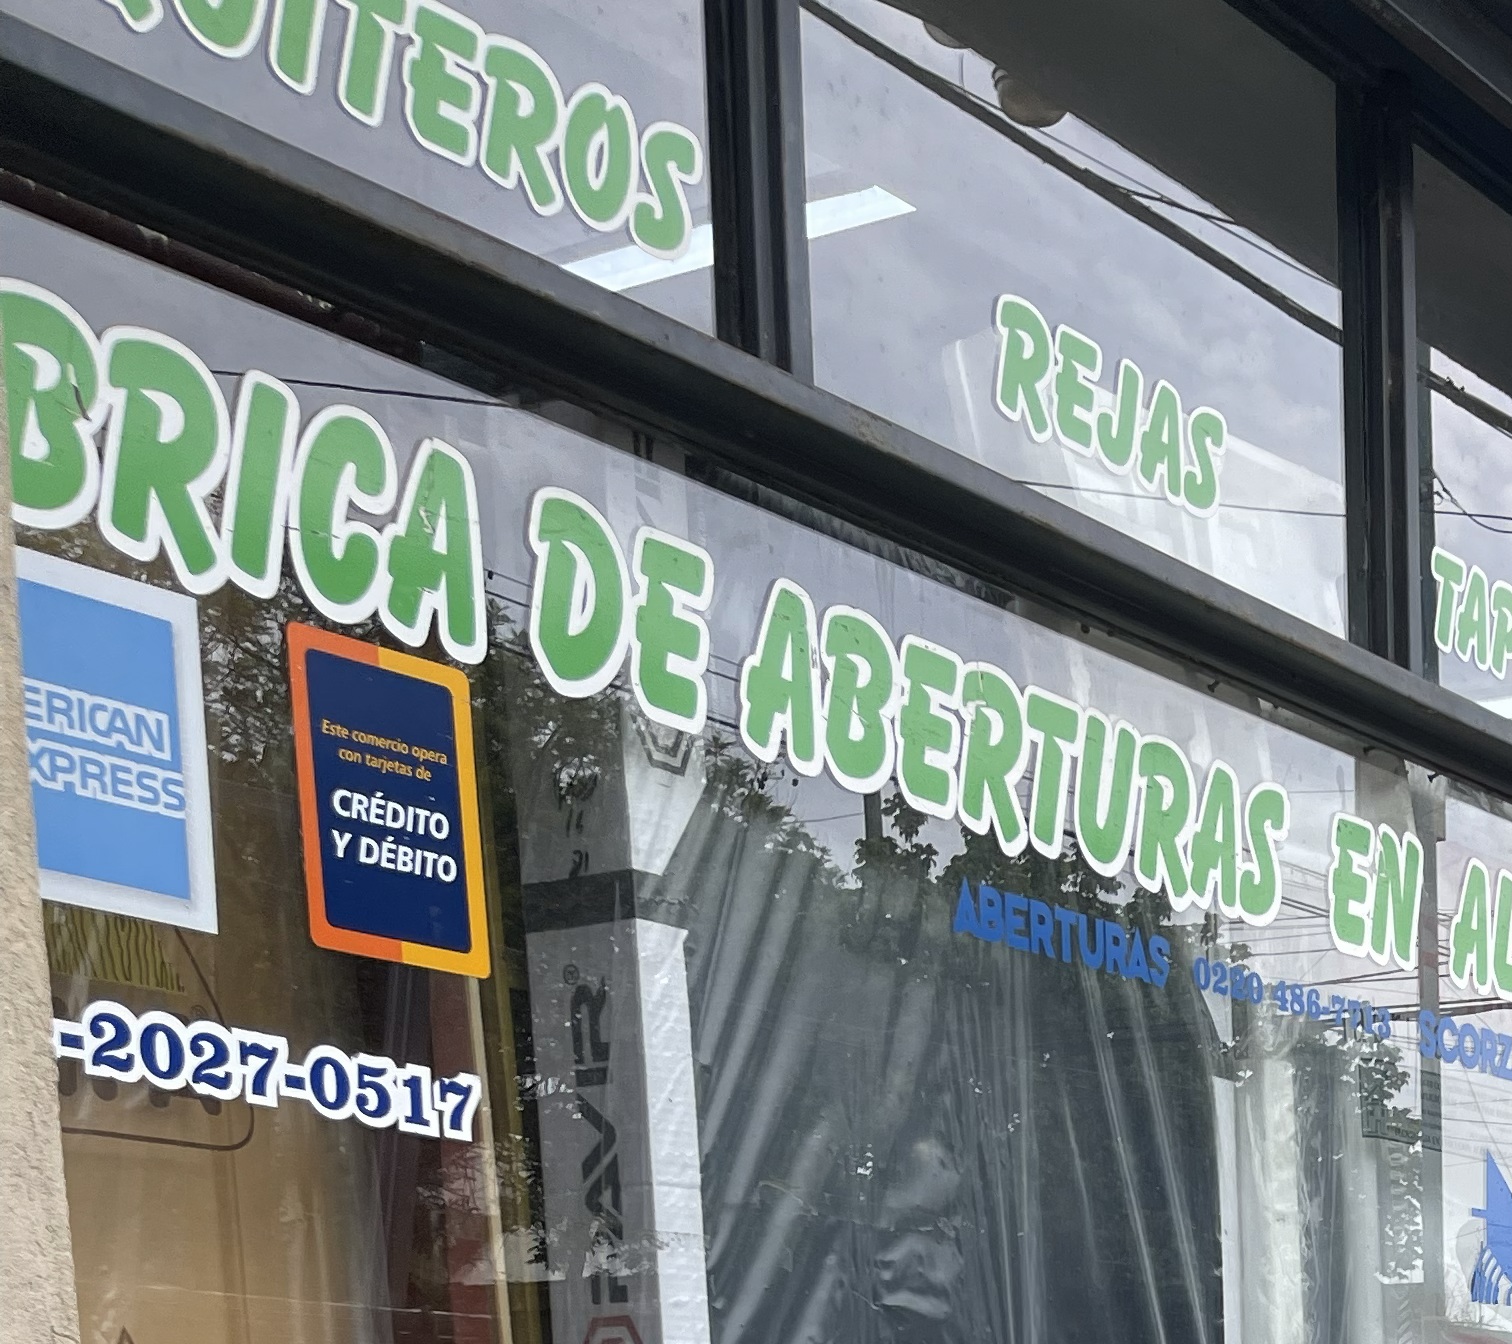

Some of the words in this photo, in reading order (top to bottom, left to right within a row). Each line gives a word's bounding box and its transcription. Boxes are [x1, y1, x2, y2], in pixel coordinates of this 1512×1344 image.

[995, 294, 1227, 518] REJAS
[321, 719, 350, 739] Este
[351, 729, 409, 755] comercio
[411, 746, 448, 765] opera
[526, 486, 715, 734] DE
[739, 576, 1290, 927] ABERTURAS
[1329, 810, 1423, 972] EN
[338, 748, 362, 764] con
[365, 754, 413, 777] tarjetas
[415, 765, 432, 782] de
[331, 787, 450, 840] CRÉDITO
[331, 828, 352, 858] Y
[358, 835, 458, 883] DÉBITO
[952, 876, 1171, 989] ABERTURAS
[1193, 957, 1264, 1005] 0220
[1272, 980, 1393, 1040] 486-7713
